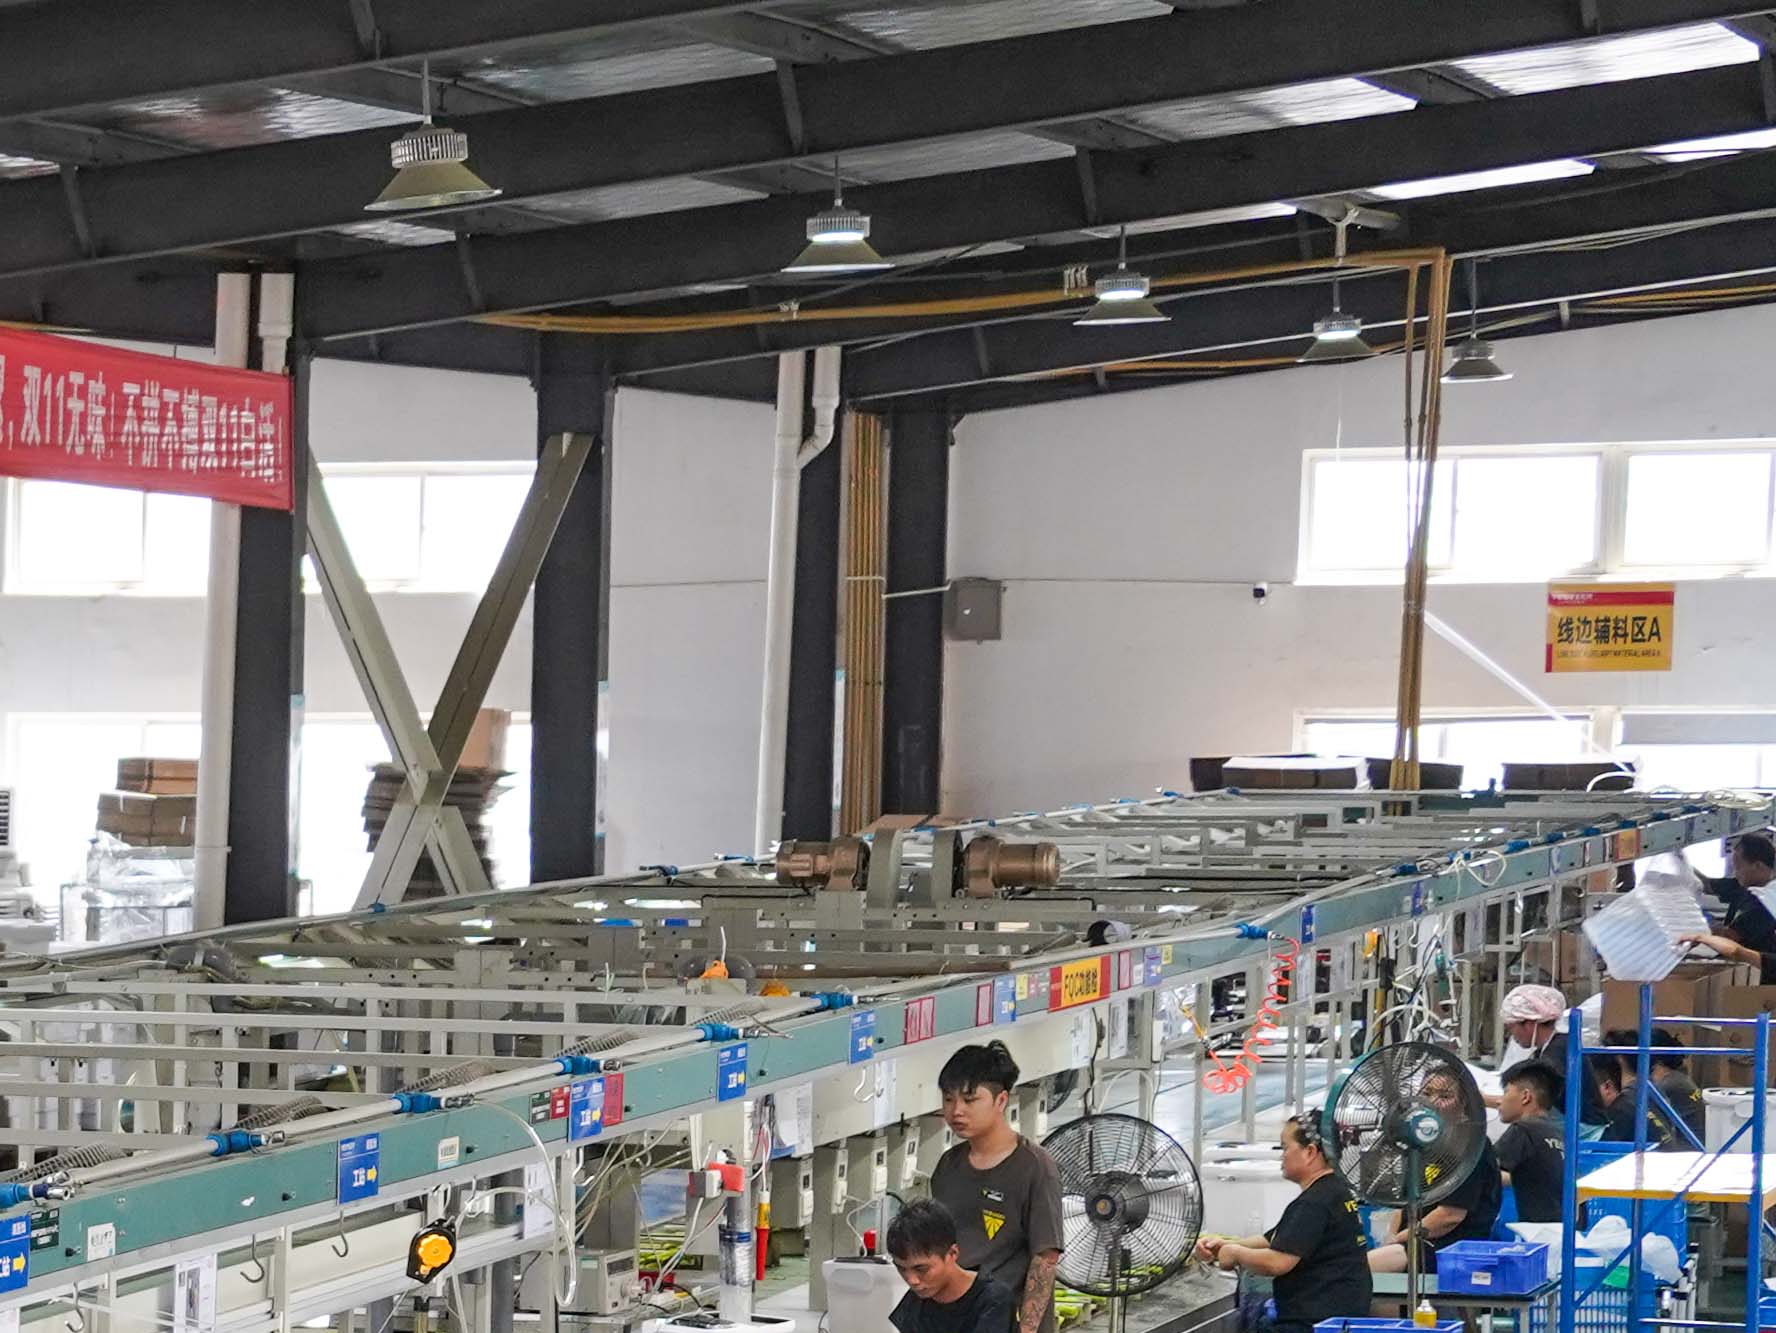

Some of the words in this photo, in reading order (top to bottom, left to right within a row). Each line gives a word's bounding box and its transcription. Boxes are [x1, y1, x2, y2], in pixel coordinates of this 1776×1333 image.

[1557, 615, 1662, 644] 线边辅料区A
